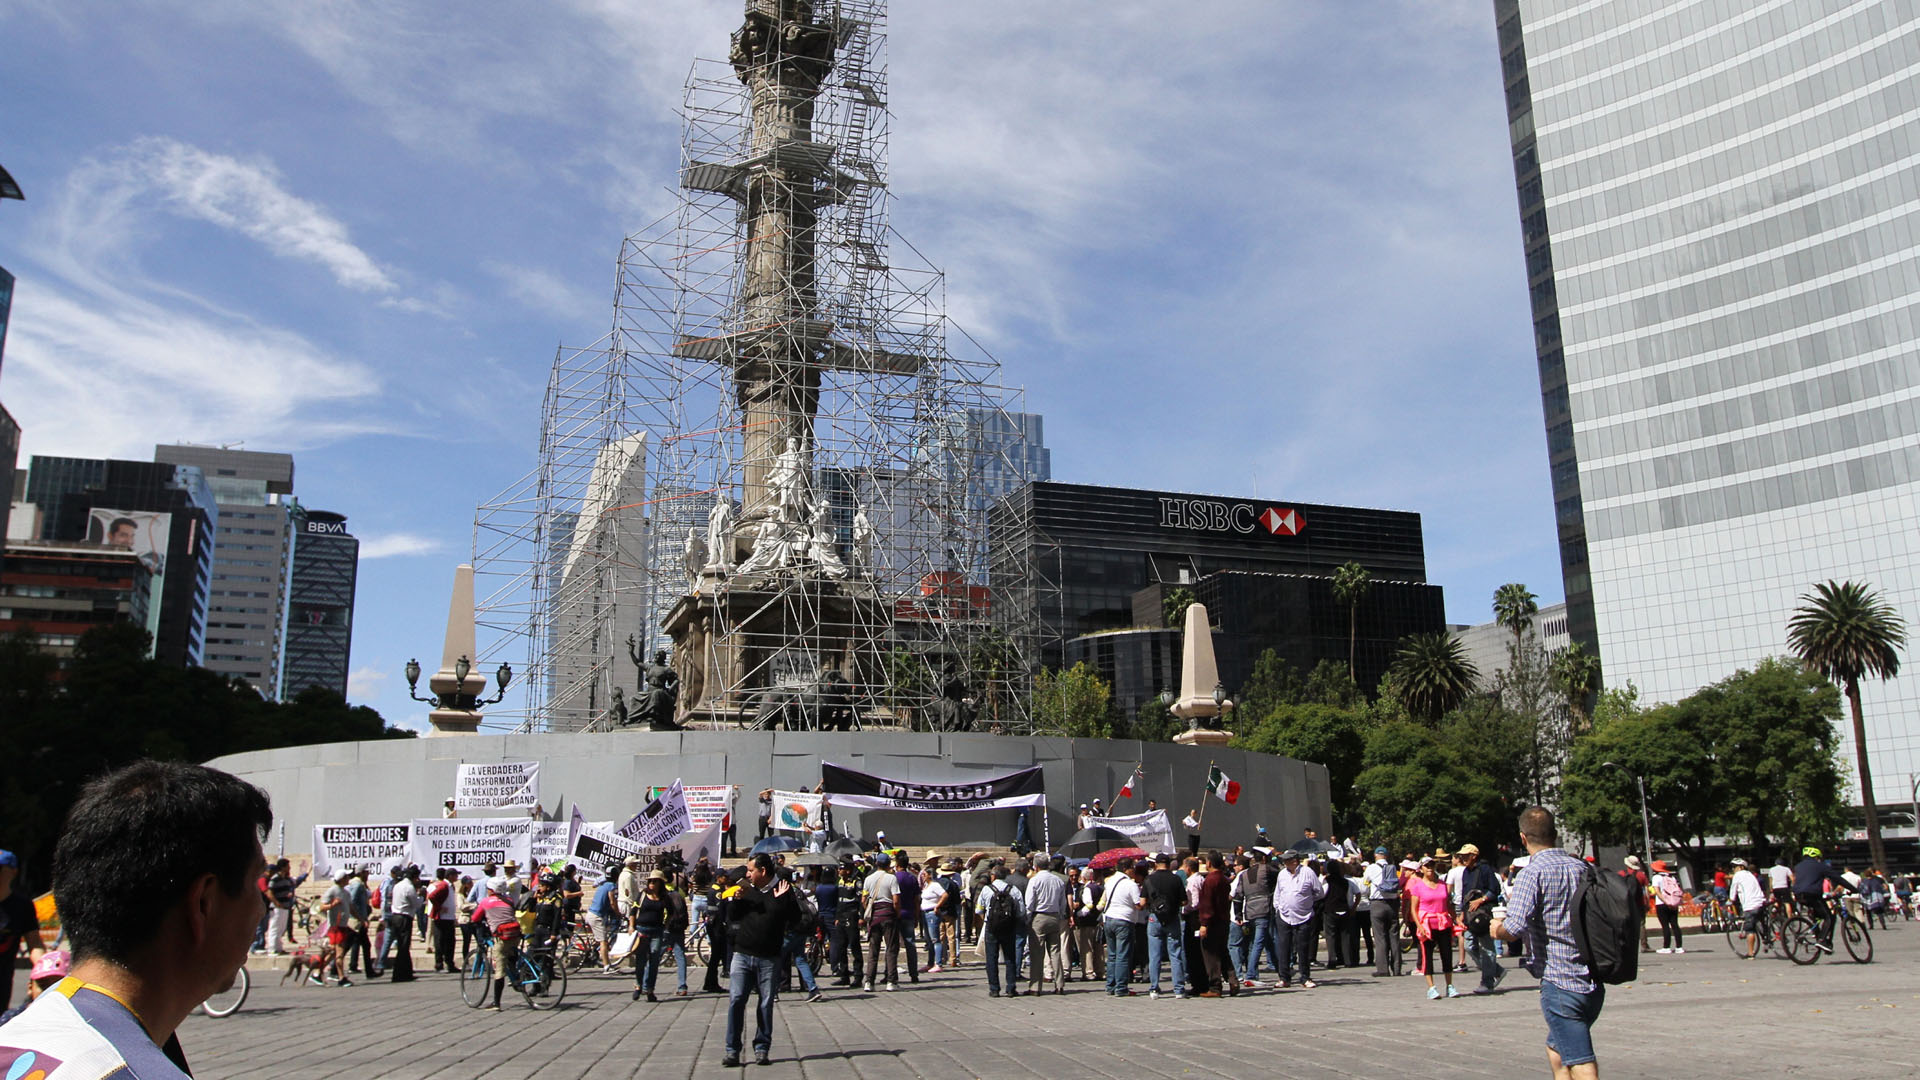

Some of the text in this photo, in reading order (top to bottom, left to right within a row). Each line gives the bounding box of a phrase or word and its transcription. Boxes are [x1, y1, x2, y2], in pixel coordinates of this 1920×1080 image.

[1159, 498, 1255, 533] HSBC
[308, 522, 344, 533] BBVA
[468, 764, 524, 775] LA VERDADERA
[462, 788, 470, 796] DE
[459, 796, 535, 807] EL PODER CIUDADANO
[662, 805, 687, 827] CONTRA
[416, 827, 426, 835] EL
[428, 825, 482, 835] CRECIMIENTO
[626, 812, 650, 836] TOTAL
[327, 828, 404, 842] LEGISLADORES:
[585, 826, 593, 835] LA
[596, 831, 655, 854] CONVOCATORIA
[432, 838, 514, 849] NO ES UN CAPRICHO.
[327, 845, 405, 859] TRABAJEN PARA
[441, 852, 504, 864] ES PROGRESO
